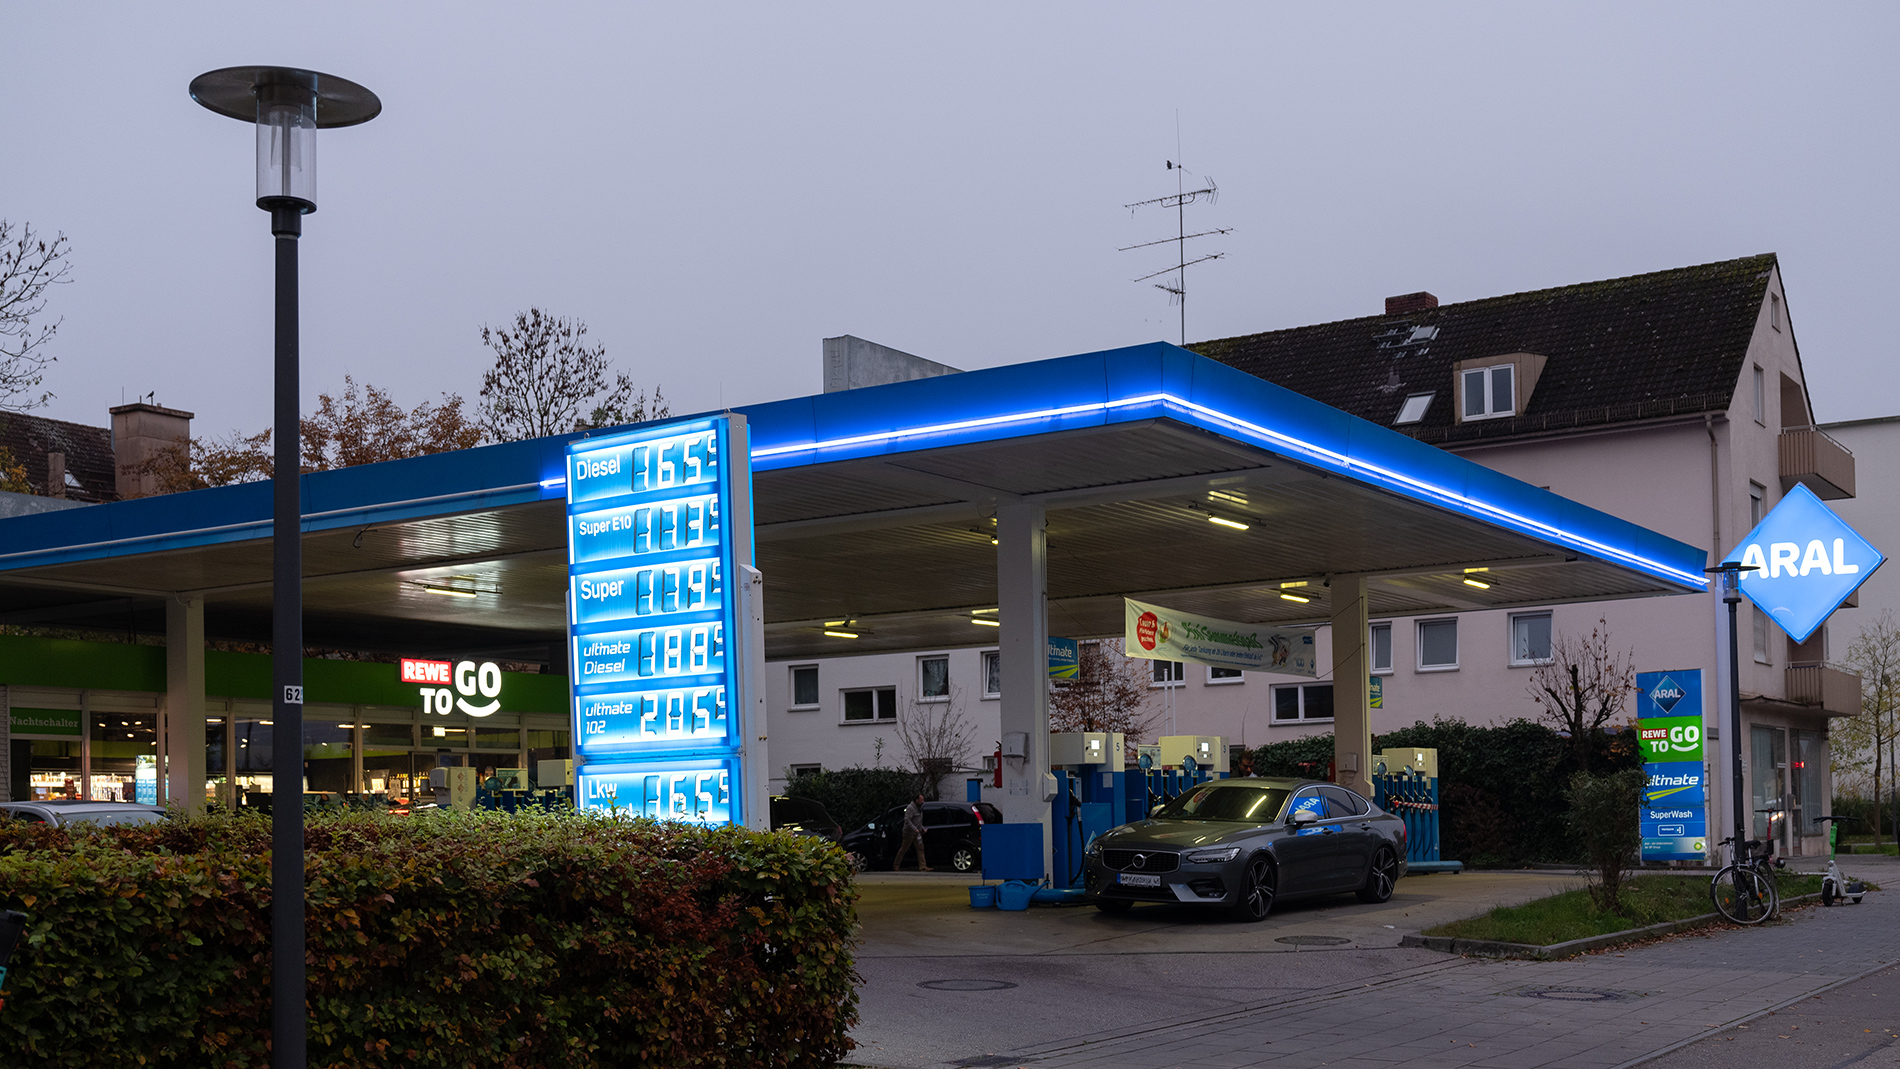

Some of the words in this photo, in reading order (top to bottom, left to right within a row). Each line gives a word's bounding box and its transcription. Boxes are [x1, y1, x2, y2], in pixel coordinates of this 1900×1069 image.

[576, 454, 621, 480] Diesel
[579, 520, 611, 536] Super
[612, 515, 632, 532] E10
[1739, 538, 1860, 581] ARAL
[581, 579, 624, 602] Super
[583, 640, 631, 657] ultimate
[584, 658, 626, 674] Diesel
[403, 662, 450, 682] REWE
[455, 660, 502, 697] GO
[285, 687, 300, 701] 62
[420, 688, 453, 715] TO
[1654, 688, 1681, 699] ARAL
[586, 700, 633, 717] ultimate
[9, 716, 79, 728] Nachtschalter
[586, 720, 606, 734] 102
[1642, 729, 1667, 739] REWE
[1670, 725, 1700, 743] GO
[1650, 740, 1669, 753] TO
[1646, 773, 1699, 787] ltimate
[588, 779, 618, 799] Lkw
[1650, 810, 1693, 820] SuperWash
